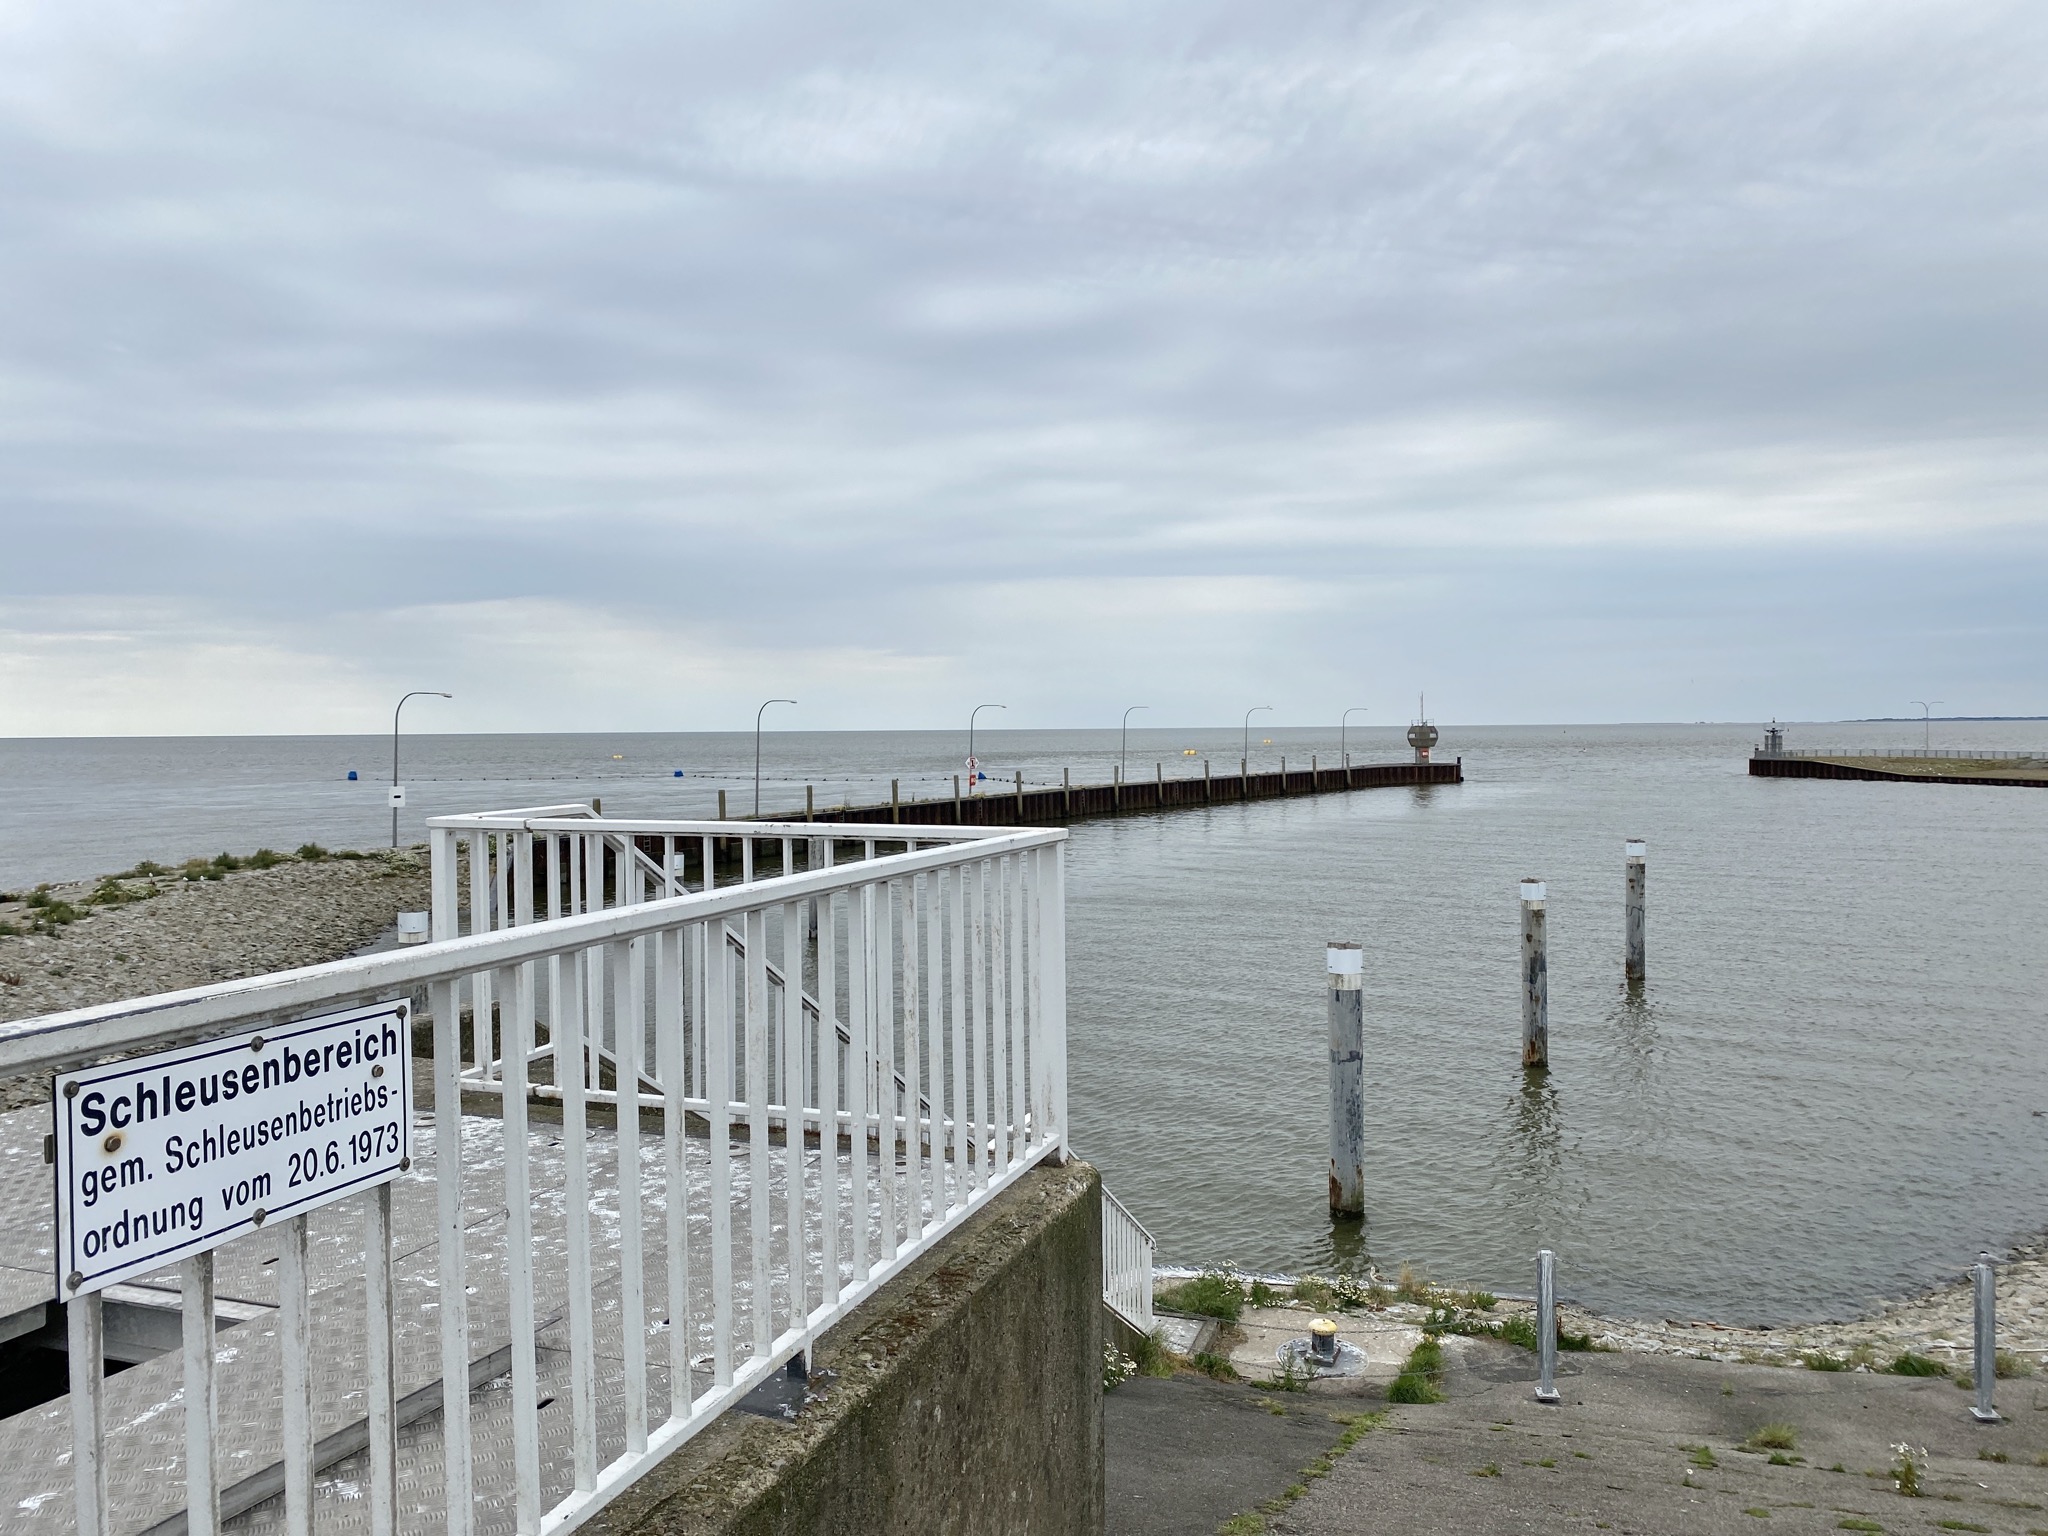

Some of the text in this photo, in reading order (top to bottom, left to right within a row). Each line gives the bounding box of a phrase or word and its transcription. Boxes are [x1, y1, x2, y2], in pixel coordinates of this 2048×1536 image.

[80, 1023, 398, 1137] Schleusenbereich
[81, 1081, 398, 1208] gem. Schleusenbetriebs-
[83, 1121, 399, 1259] ordnung vom 20.6.1973
